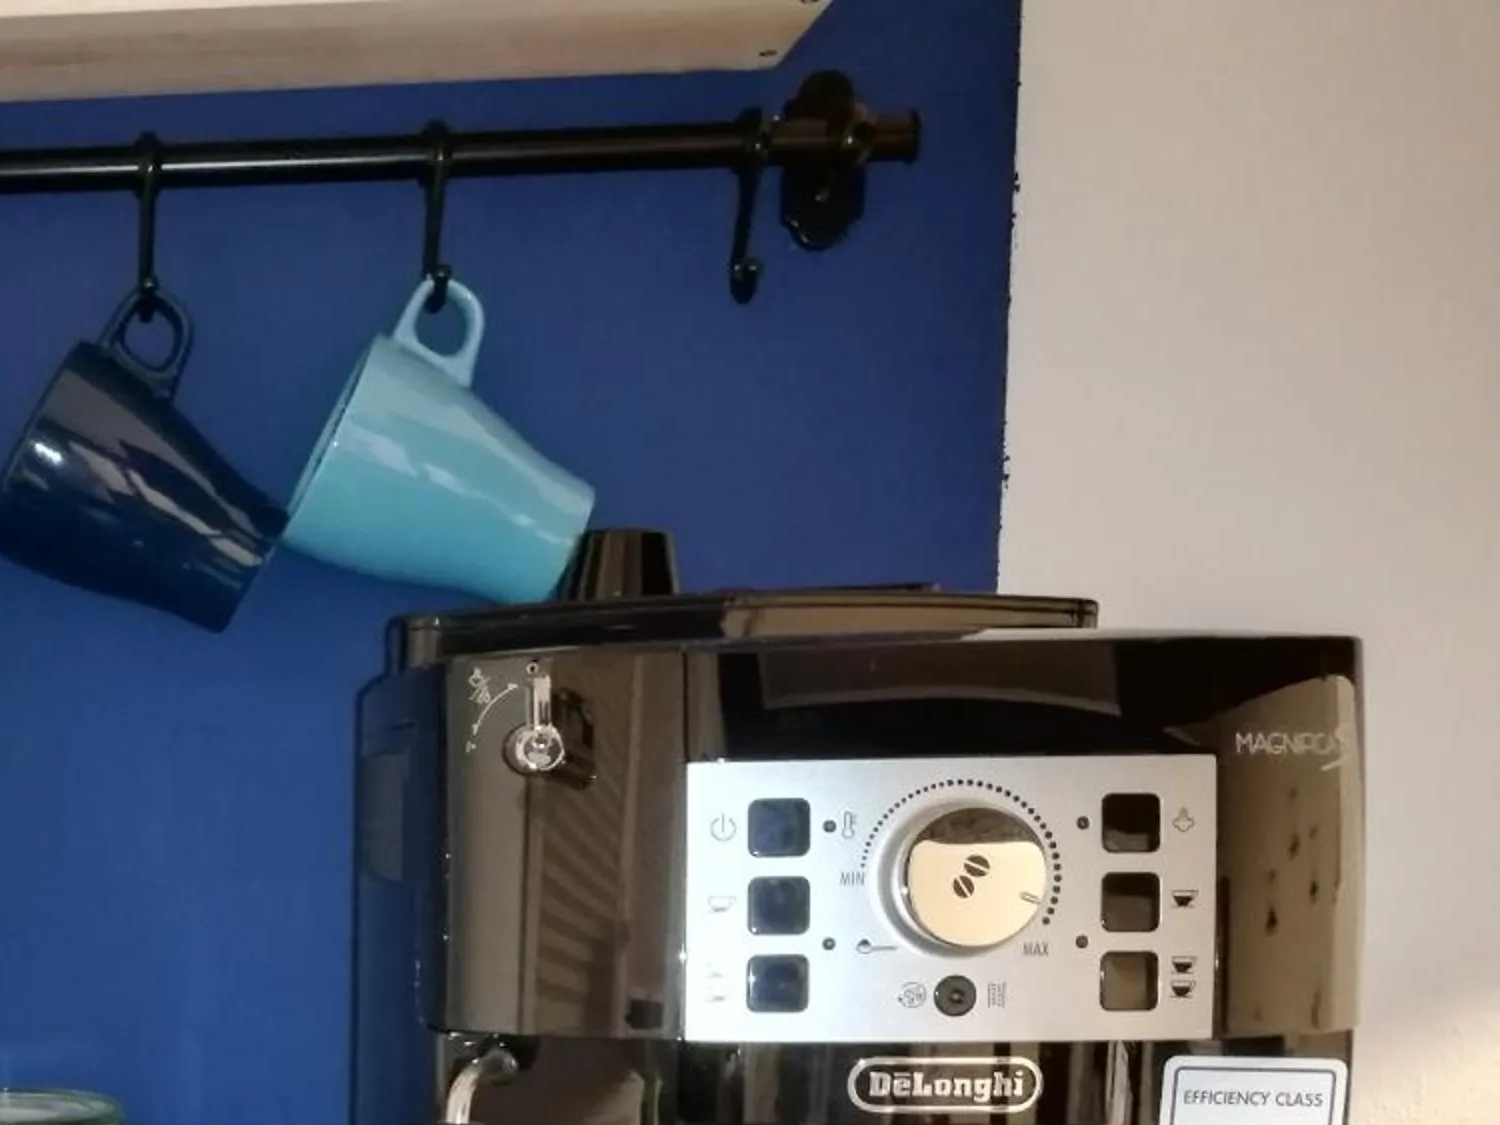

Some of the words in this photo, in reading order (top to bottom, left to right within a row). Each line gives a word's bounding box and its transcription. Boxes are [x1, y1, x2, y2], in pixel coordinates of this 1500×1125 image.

[839, 871, 866, 886] MIN
[1023, 942, 1050, 956] MAX
[1183, 1089, 1270, 1106] EFFICIENCY
[1275, 1091, 1323, 1107] CLASS
